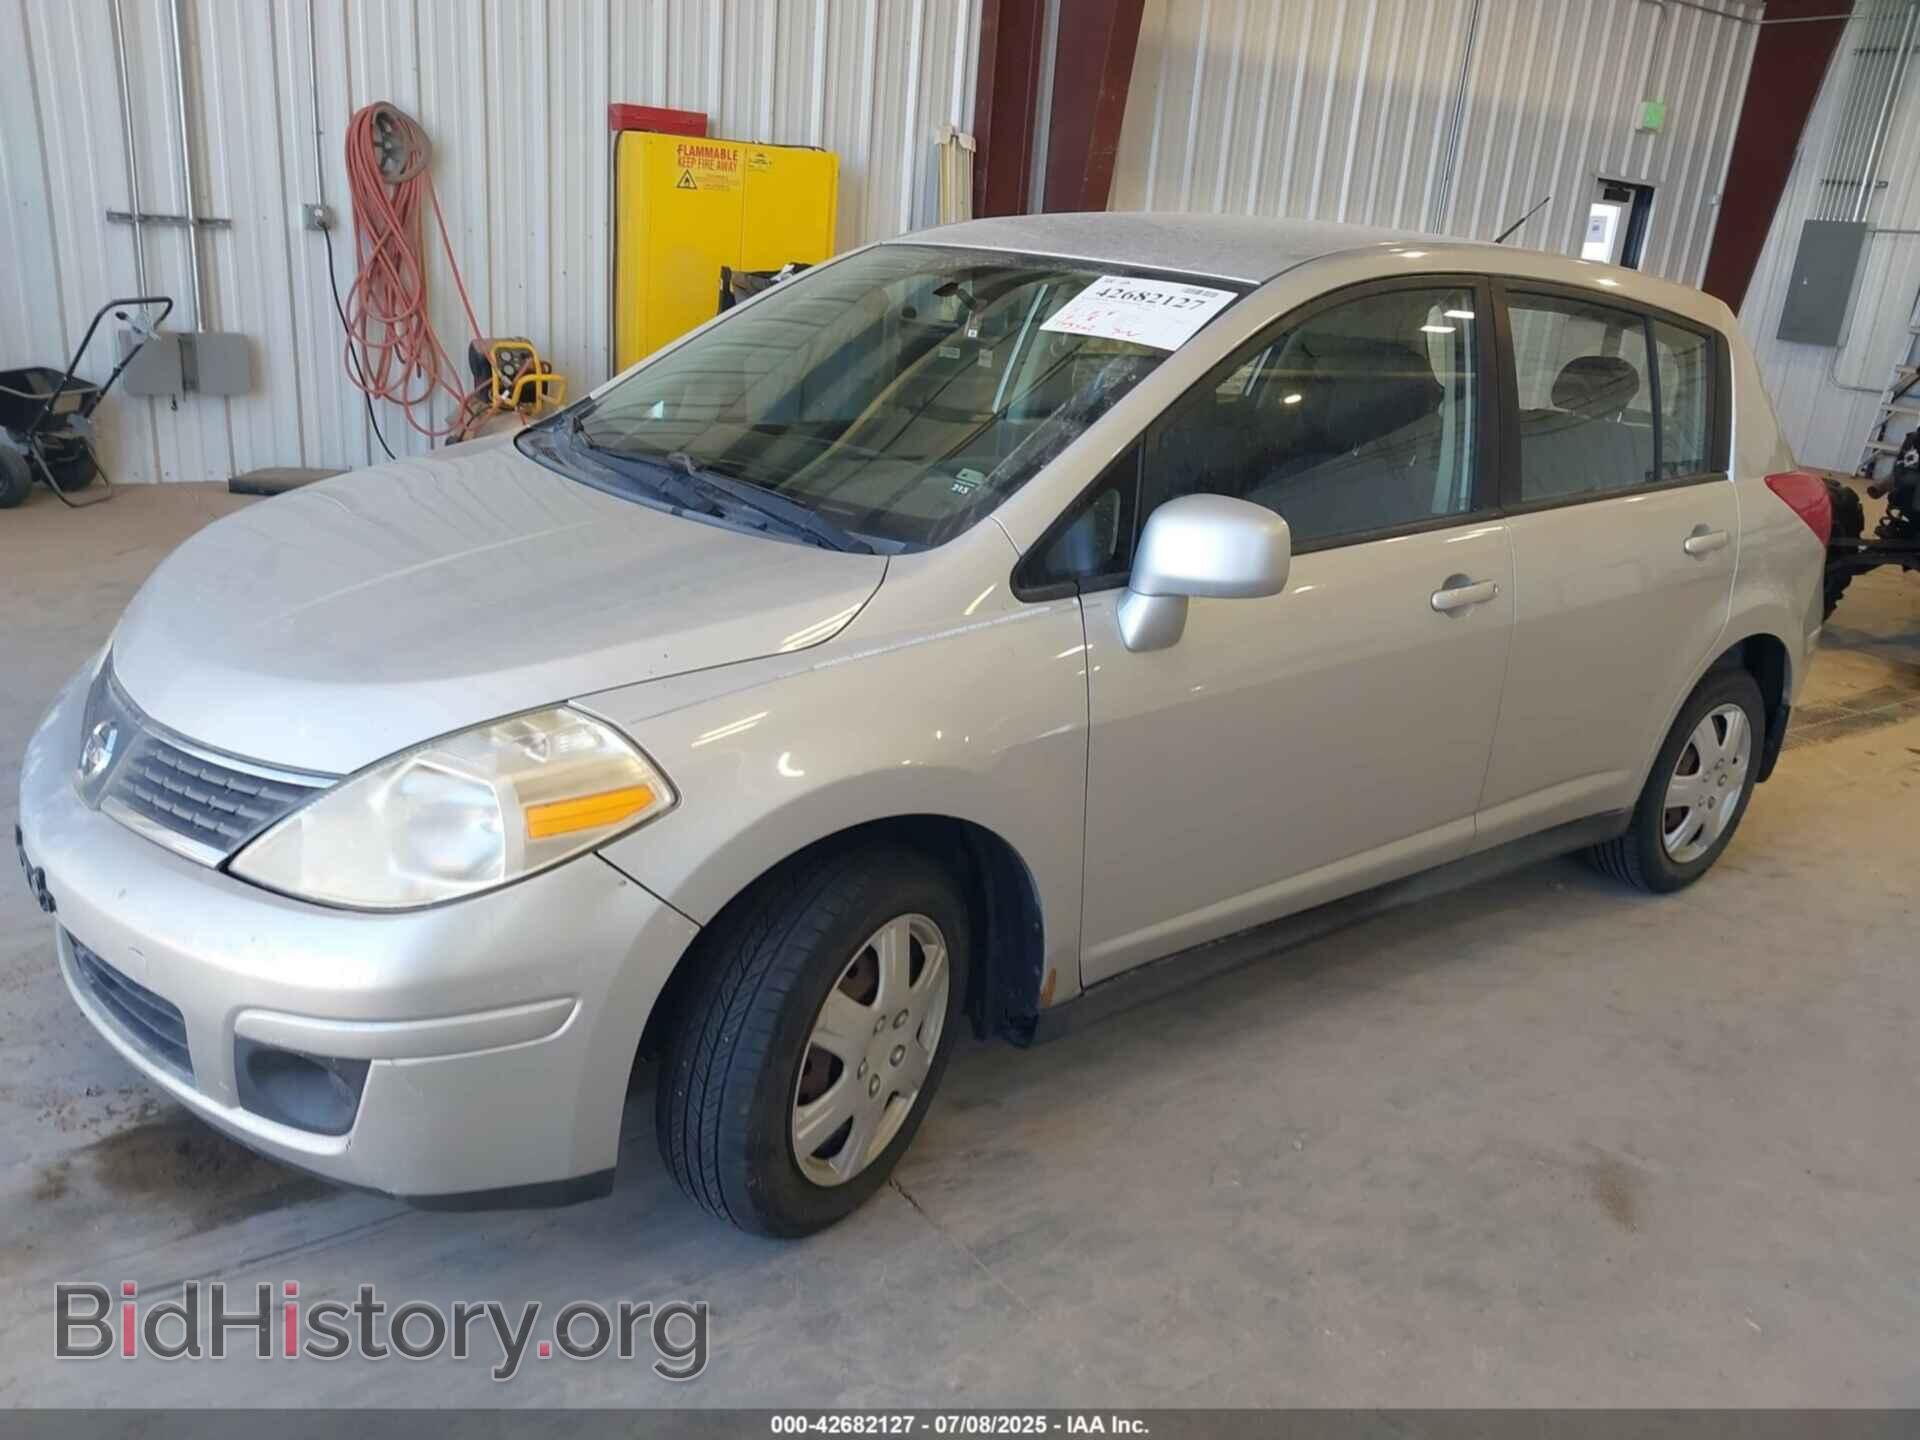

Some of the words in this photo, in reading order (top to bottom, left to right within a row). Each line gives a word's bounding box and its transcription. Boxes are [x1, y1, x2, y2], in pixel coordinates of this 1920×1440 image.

[677, 144, 738, 161] FLAMMABLE
[678, 157, 696, 169] KEEP
[698, 159, 715, 171] FIRE
[716, 160, 737, 172] AWAY
[1096, 287, 1206, 311] 42682127
